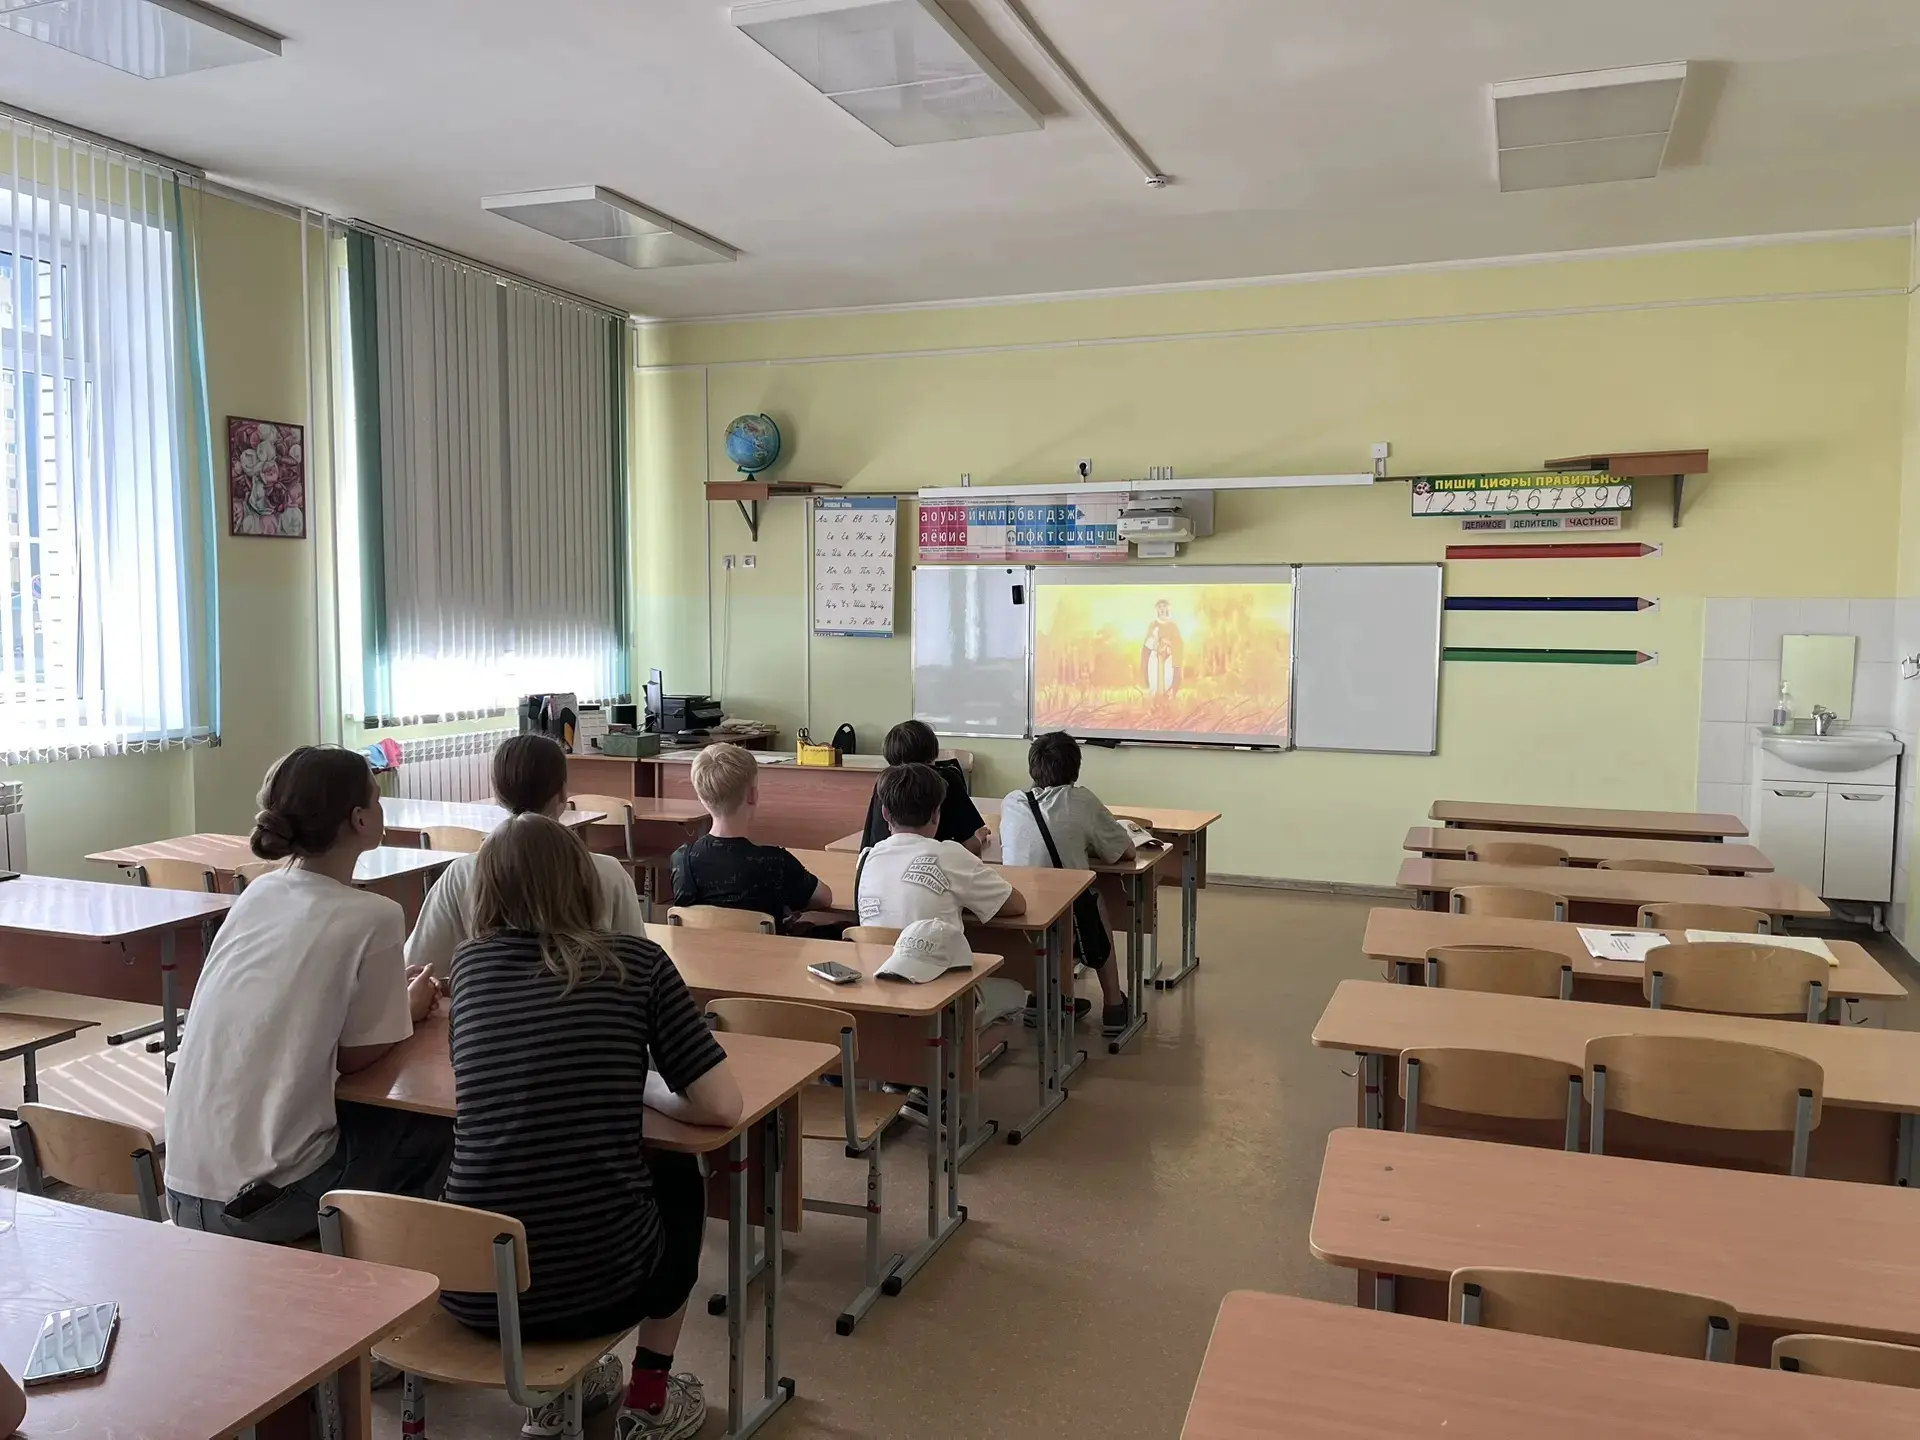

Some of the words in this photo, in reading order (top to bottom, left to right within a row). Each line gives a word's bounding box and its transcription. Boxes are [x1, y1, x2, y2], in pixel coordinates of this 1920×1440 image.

[1435, 479, 1476, 489] ПИШИ
[1480, 477, 1530, 488] ЦИФРЫ
[1465, 520, 1502, 530] ДЕЛИМОЕ
[1513, 519, 1559, 529] ДЕЛИТЕЛЬ
[1569, 517, 1615, 527] ЧАСТНОЕ
